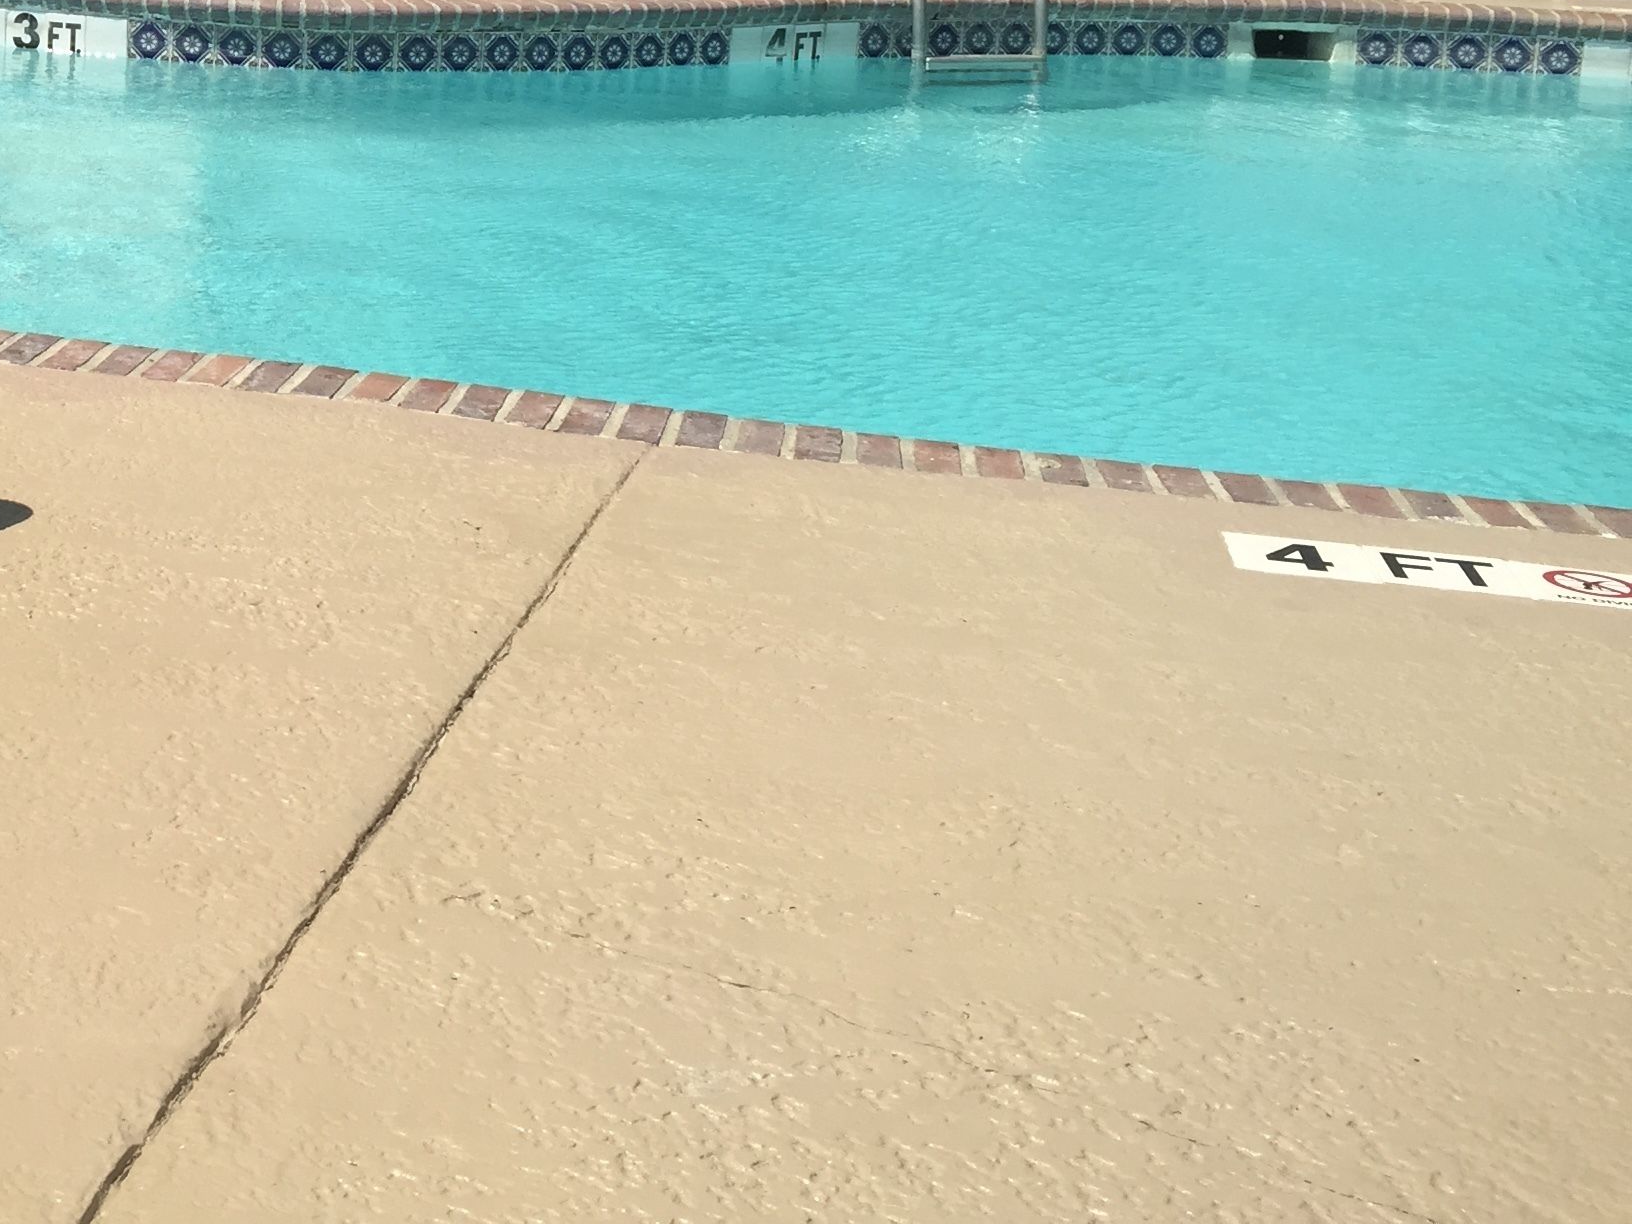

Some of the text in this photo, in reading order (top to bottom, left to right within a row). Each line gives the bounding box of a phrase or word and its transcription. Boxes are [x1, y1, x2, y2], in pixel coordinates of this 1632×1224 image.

[12, 12, 41, 49] 3
[764, 28, 787, 63] 4
[1265, 543, 1494, 588] 4 FT
[1591, 598, 1632, 607] DIVI
